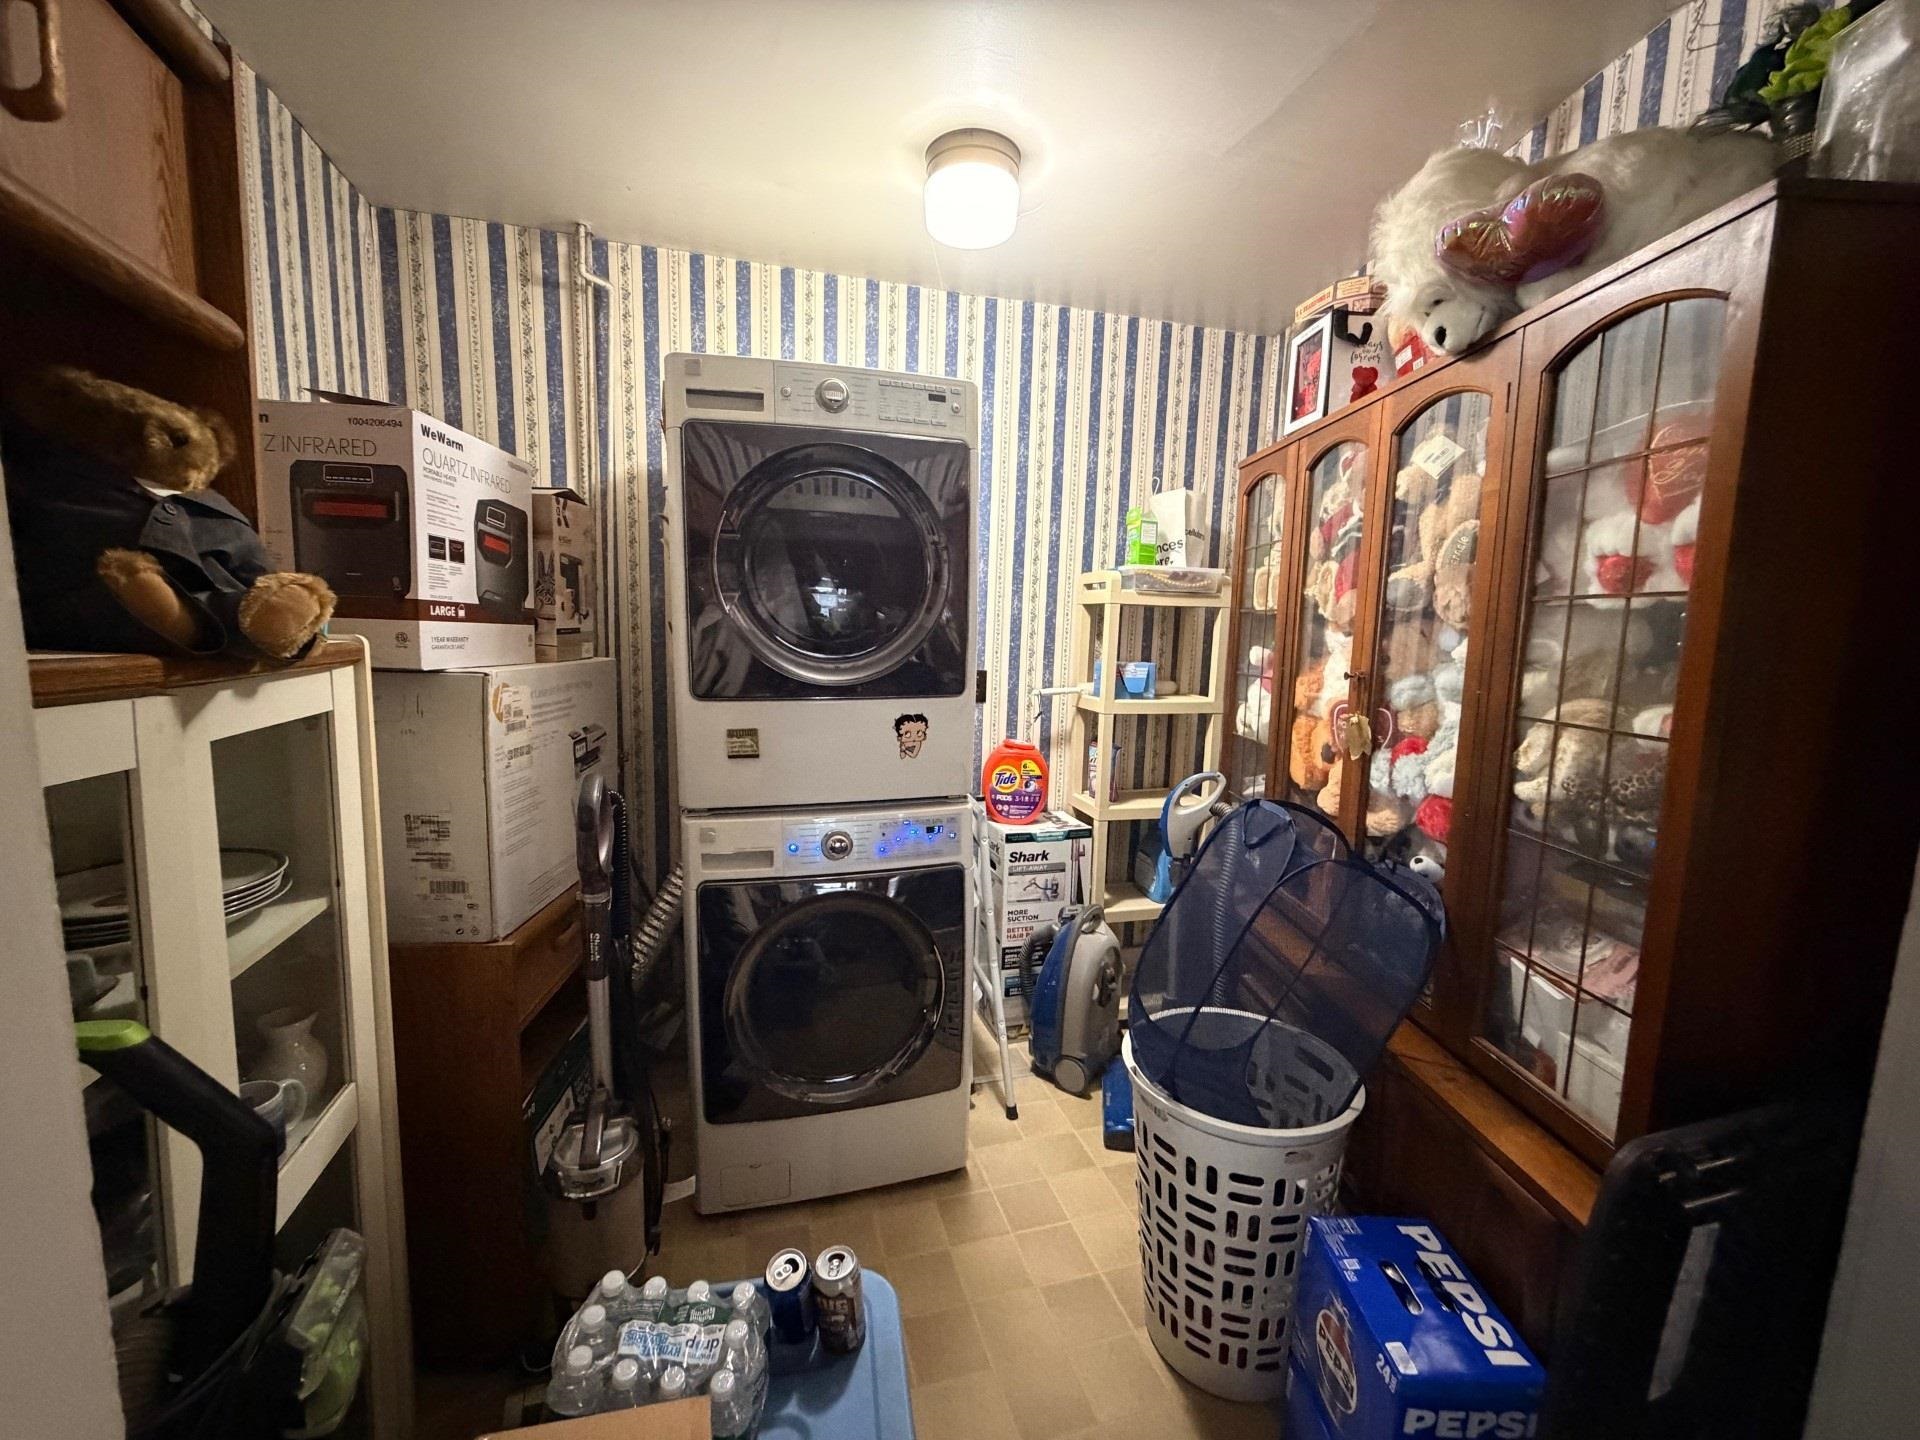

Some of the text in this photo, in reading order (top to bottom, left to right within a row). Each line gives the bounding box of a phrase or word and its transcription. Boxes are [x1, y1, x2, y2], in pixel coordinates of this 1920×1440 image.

[347, 416, 403, 428] 1004206494
[281, 434, 378, 457] INFRARED
[420, 424, 464, 452] WeWarm
[422, 447, 470, 479] QUARTZ
[470, 466, 512, 494] INFRARED
[1155, 539, 1184, 553] nces
[429, 604, 456, 617] LARGE
[995, 772, 1018, 787] Tide
[1008, 850, 1050, 863] Shark
[1007, 914, 1039, 922] SUCTION
[1396, 1225, 1532, 1367] PEPSI
[1318, 1322, 1354, 1400] PEPSI
